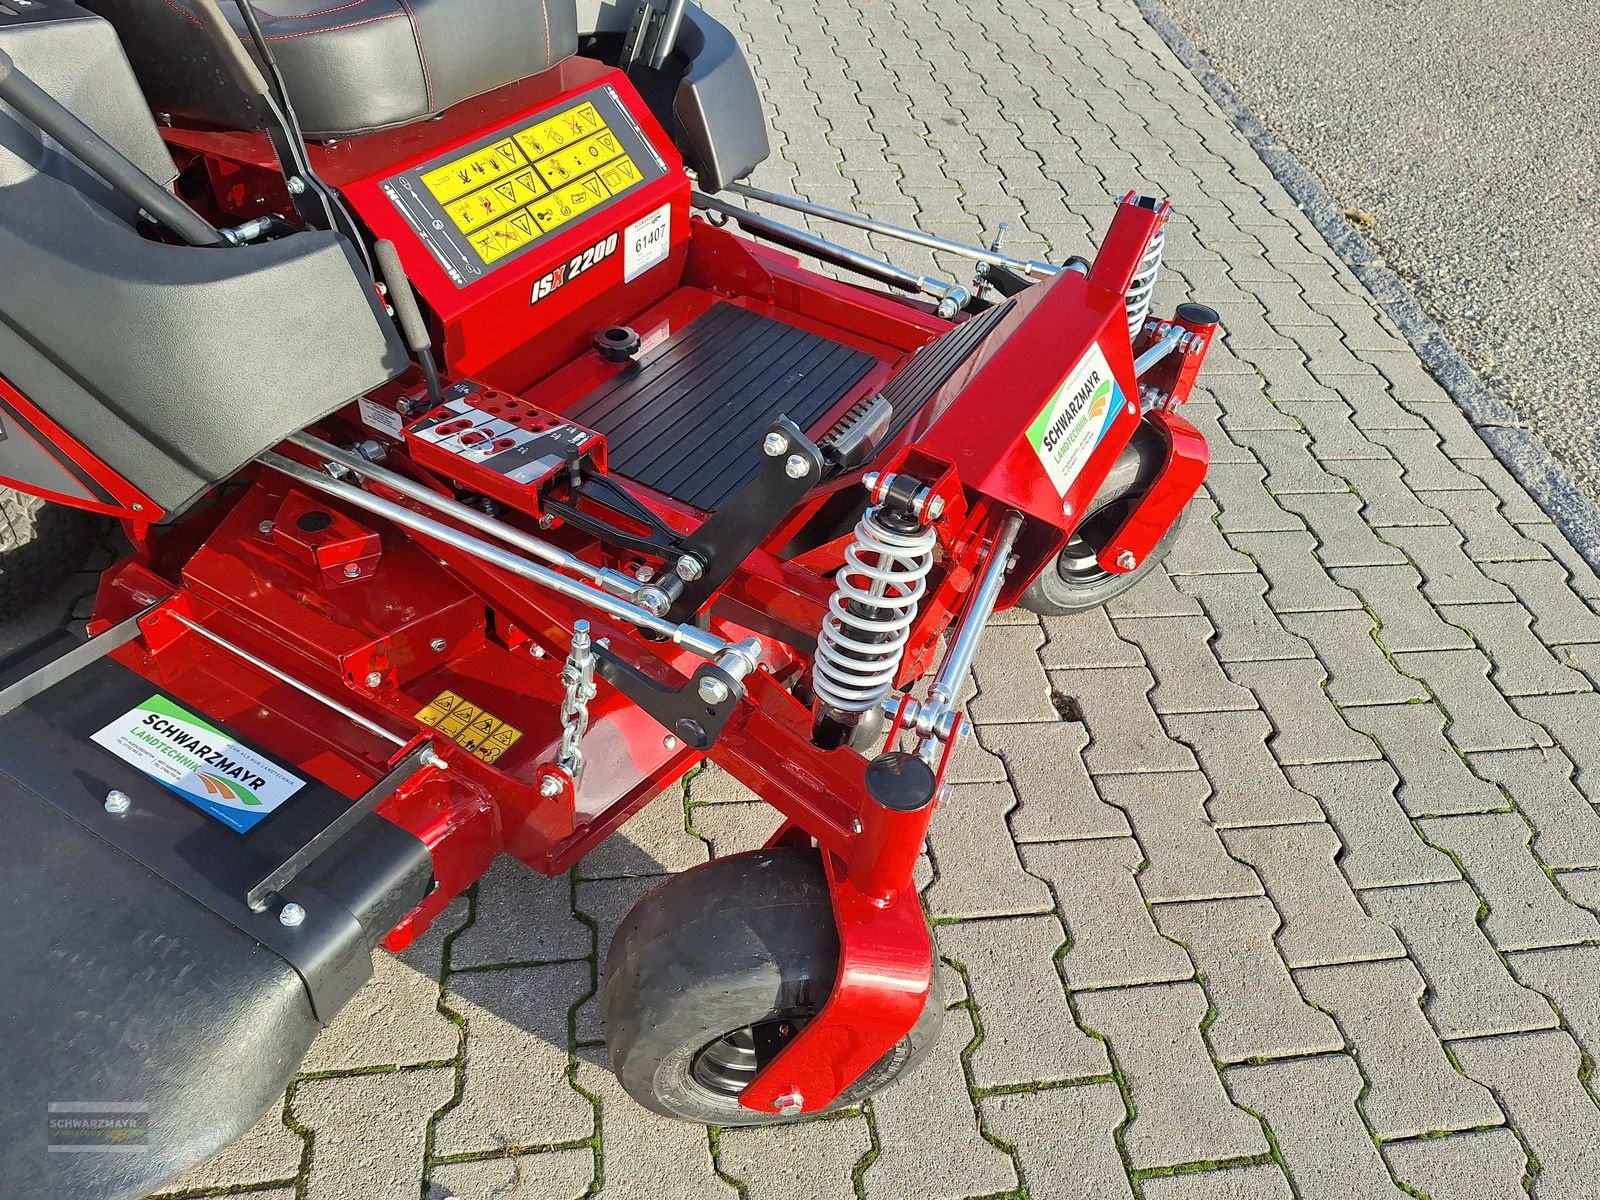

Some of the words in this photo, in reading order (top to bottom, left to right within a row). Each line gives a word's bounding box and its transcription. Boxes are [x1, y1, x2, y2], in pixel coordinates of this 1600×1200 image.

[530, 264, 567, 304] ISX
[567, 231, 619, 280] 2200
[635, 223, 666, 253] 61407
[1043, 370, 1101, 452] SCHWARZMAYR
[1053, 415, 1089, 464] LANDTECHNIK
[129, 726, 203, 773] LANDTECHNIK
[142, 713, 267, 791] SCHWARZMAYR
